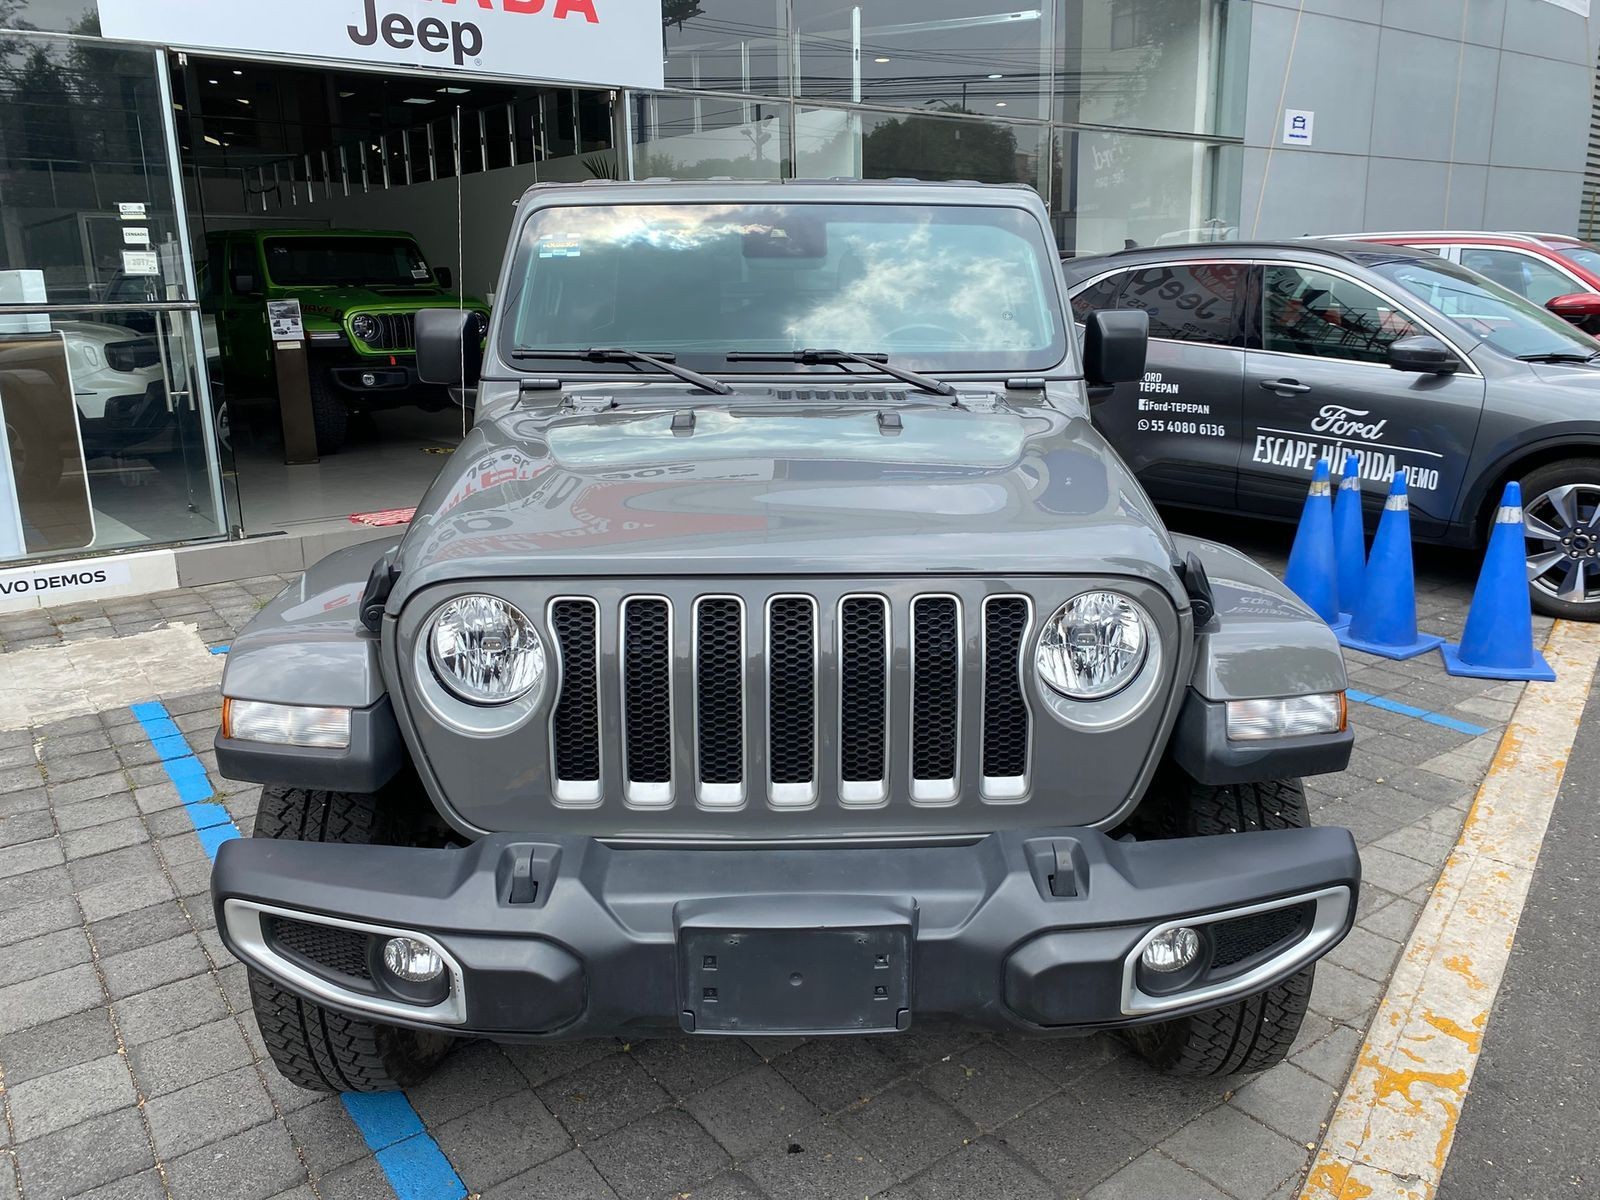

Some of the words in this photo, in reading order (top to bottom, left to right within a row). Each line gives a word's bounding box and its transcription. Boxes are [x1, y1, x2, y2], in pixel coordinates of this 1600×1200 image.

[347, 0, 483, 65] Jeep
[1140, 372, 1162, 383] ORD
[1139, 382, 1179, 394] TEPEPAN
[1149, 401, 1210, 414] Ford-TEPEPAN
[1151, 420, 1164, 432] 55
[1167, 421, 1196, 434] 4080
[1199, 423, 1225, 437] 6136
[1311, 404, 1388, 440] Ford
[1252, 435, 1318, 471] ESCAPE
[1402, 464, 1439, 491] DEMO
[34, 570, 107, 591] DEMOS
